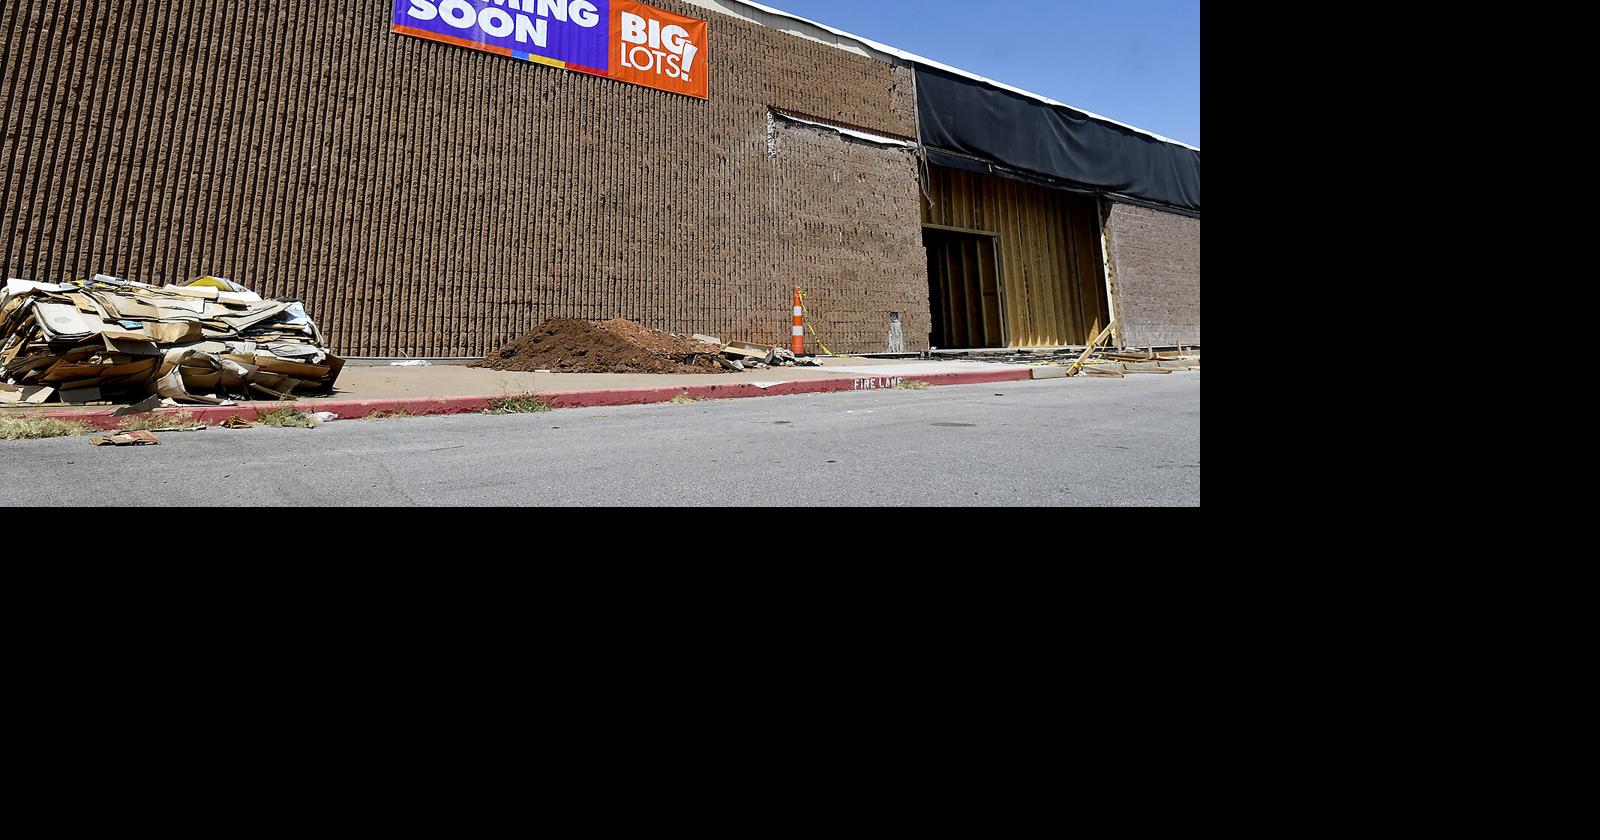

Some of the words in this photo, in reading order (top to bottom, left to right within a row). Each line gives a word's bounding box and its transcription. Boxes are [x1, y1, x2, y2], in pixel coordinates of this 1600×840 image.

[406, 0, 548, 48] SOON
[480, 0, 600, 28] ING
[621, 11, 692, 55] BIG
[621, 42, 699, 82] LOTS!
[854, 378, 876, 390] FIRE
